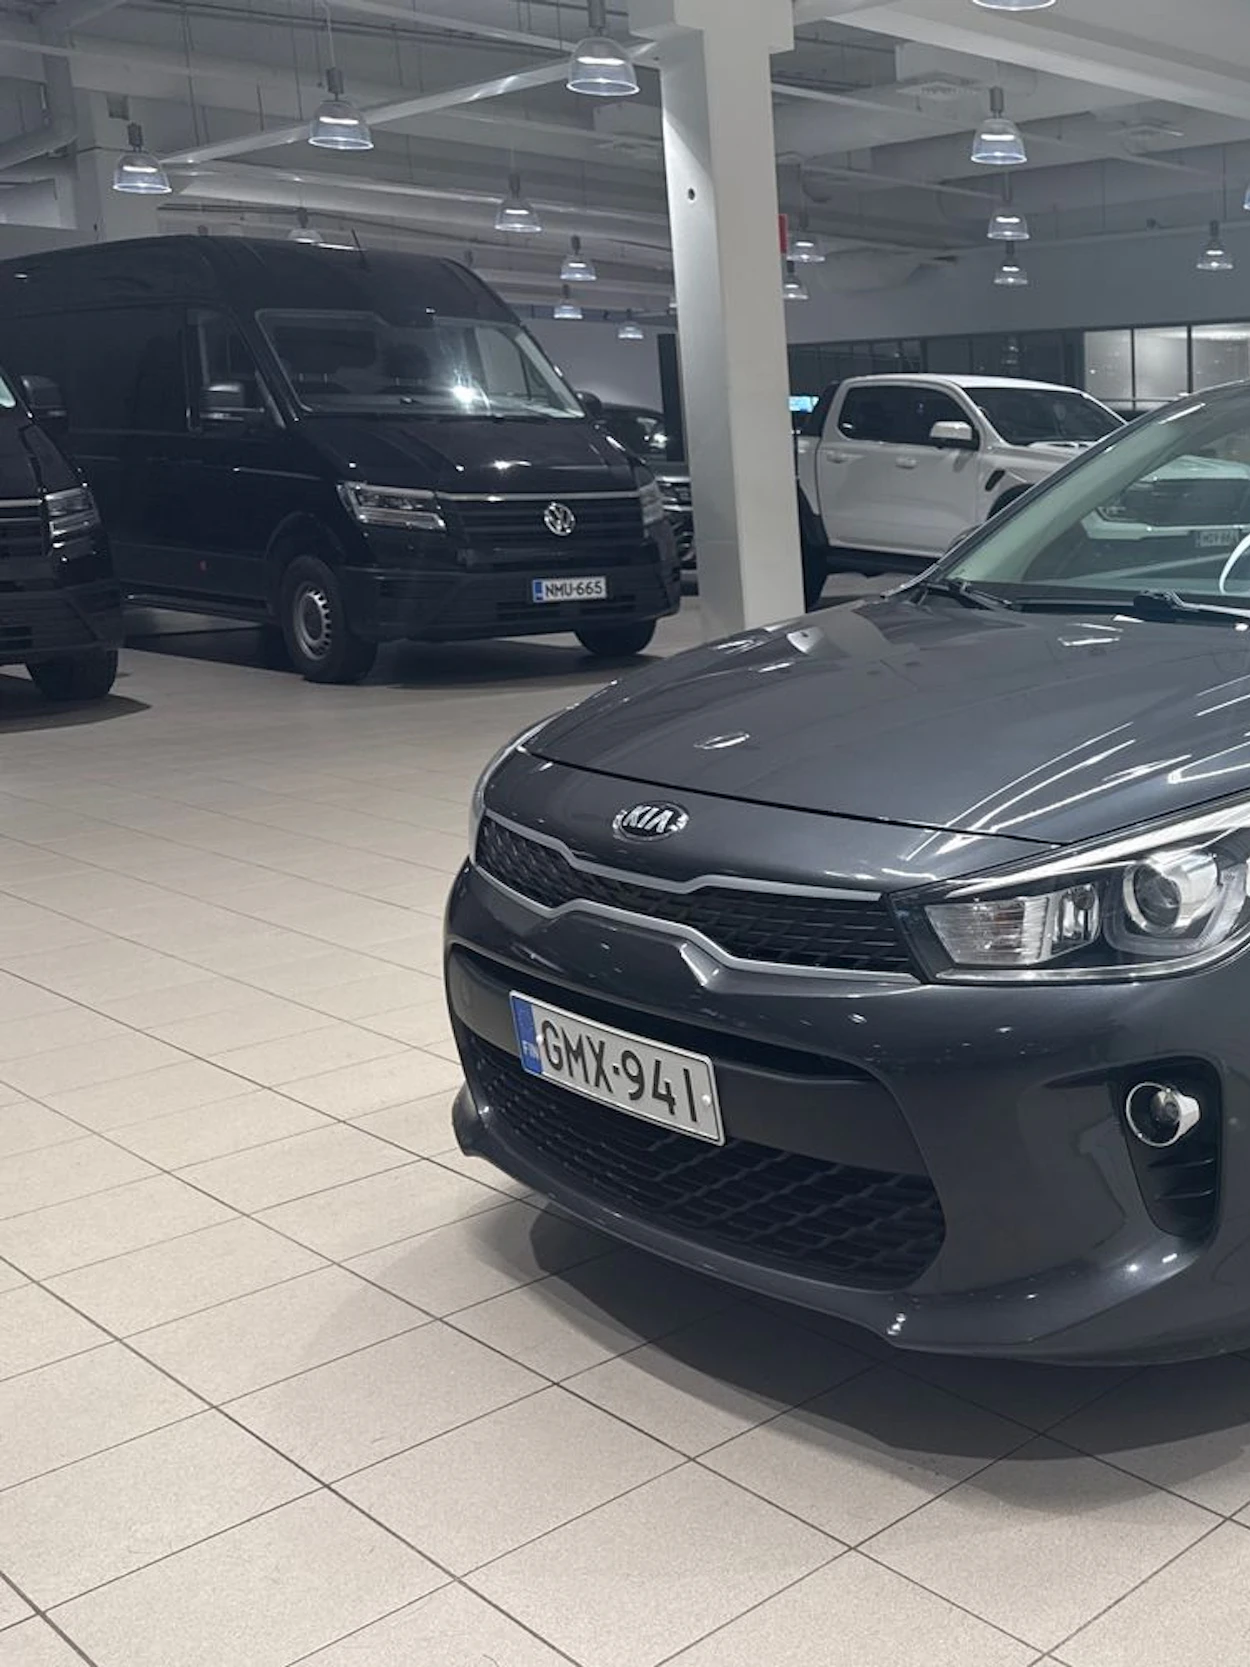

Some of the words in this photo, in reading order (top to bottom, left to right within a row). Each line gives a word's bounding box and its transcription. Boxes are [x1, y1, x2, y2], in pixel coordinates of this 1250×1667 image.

[545, 581, 603, 598] NMU-665
[622, 804, 675, 834] KIA
[541, 1020, 698, 1123] GMX-941
